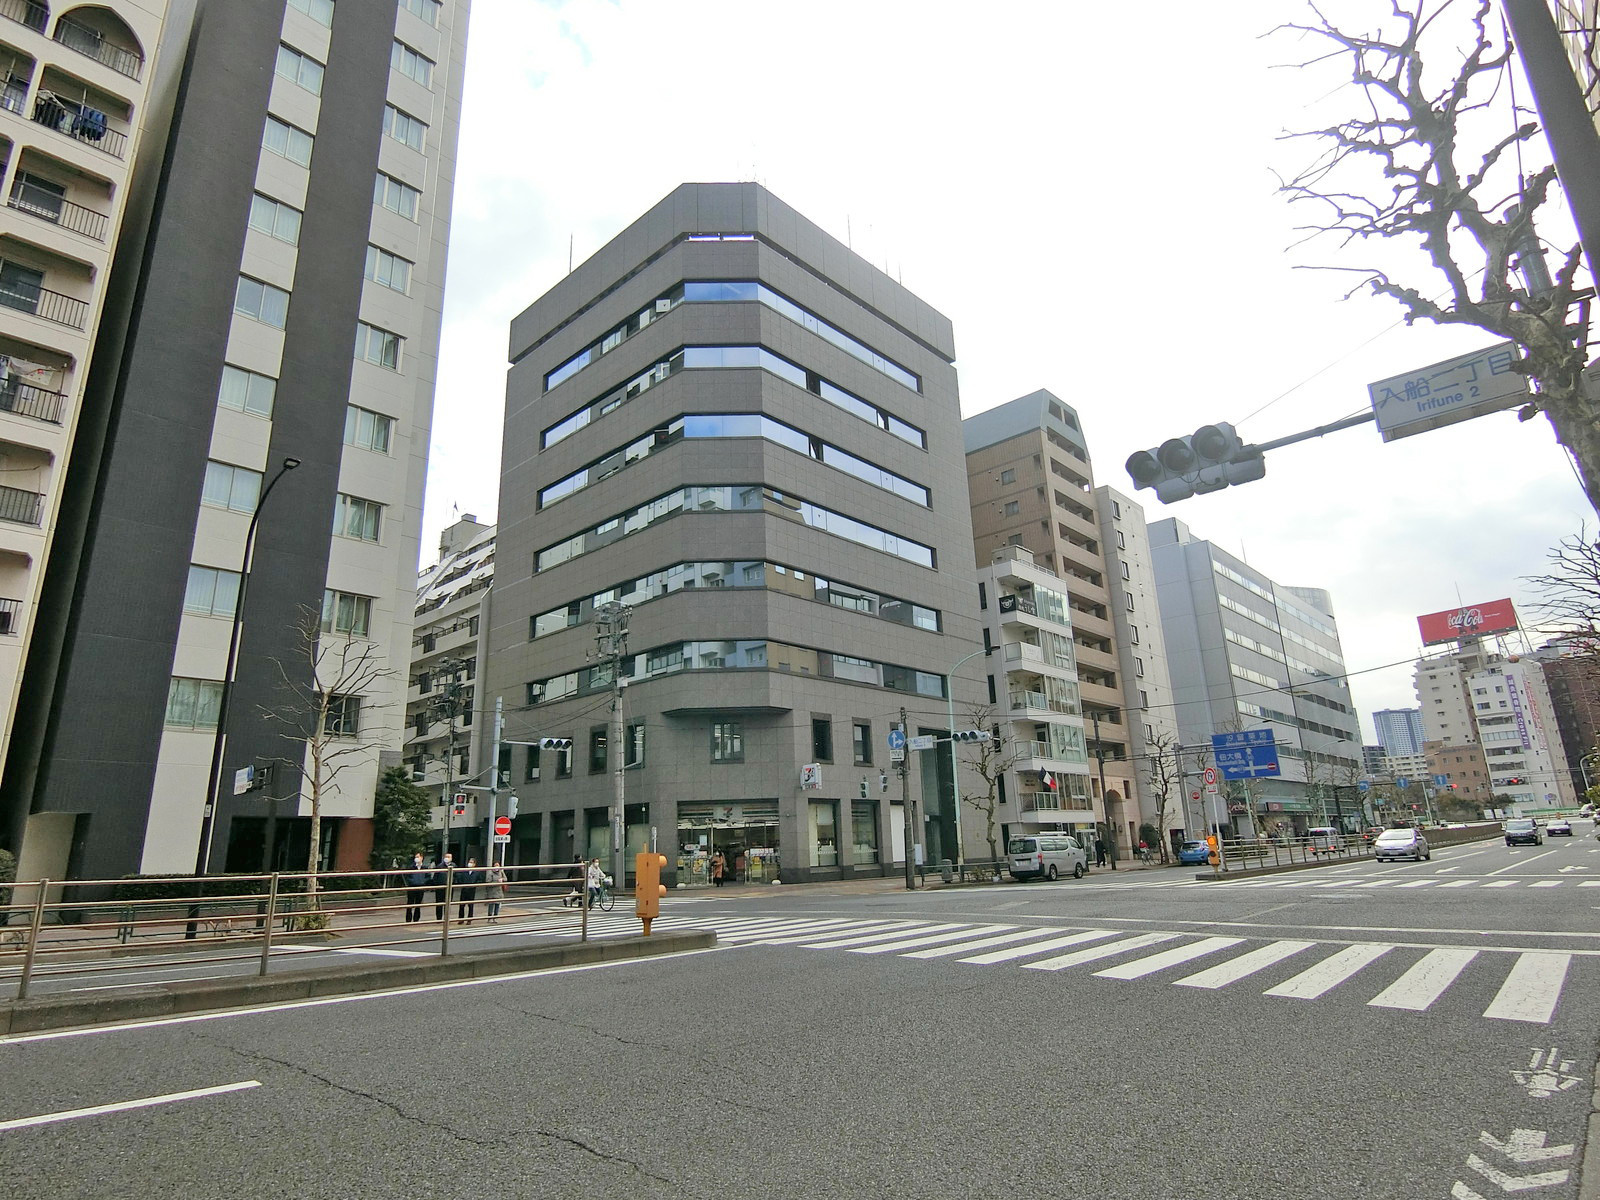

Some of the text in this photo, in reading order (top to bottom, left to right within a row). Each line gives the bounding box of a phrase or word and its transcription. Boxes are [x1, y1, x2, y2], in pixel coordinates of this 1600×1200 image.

[1379, 351, 1513, 409] 入船二丁目
[1417, 386, 1481, 413] Irifune 2
